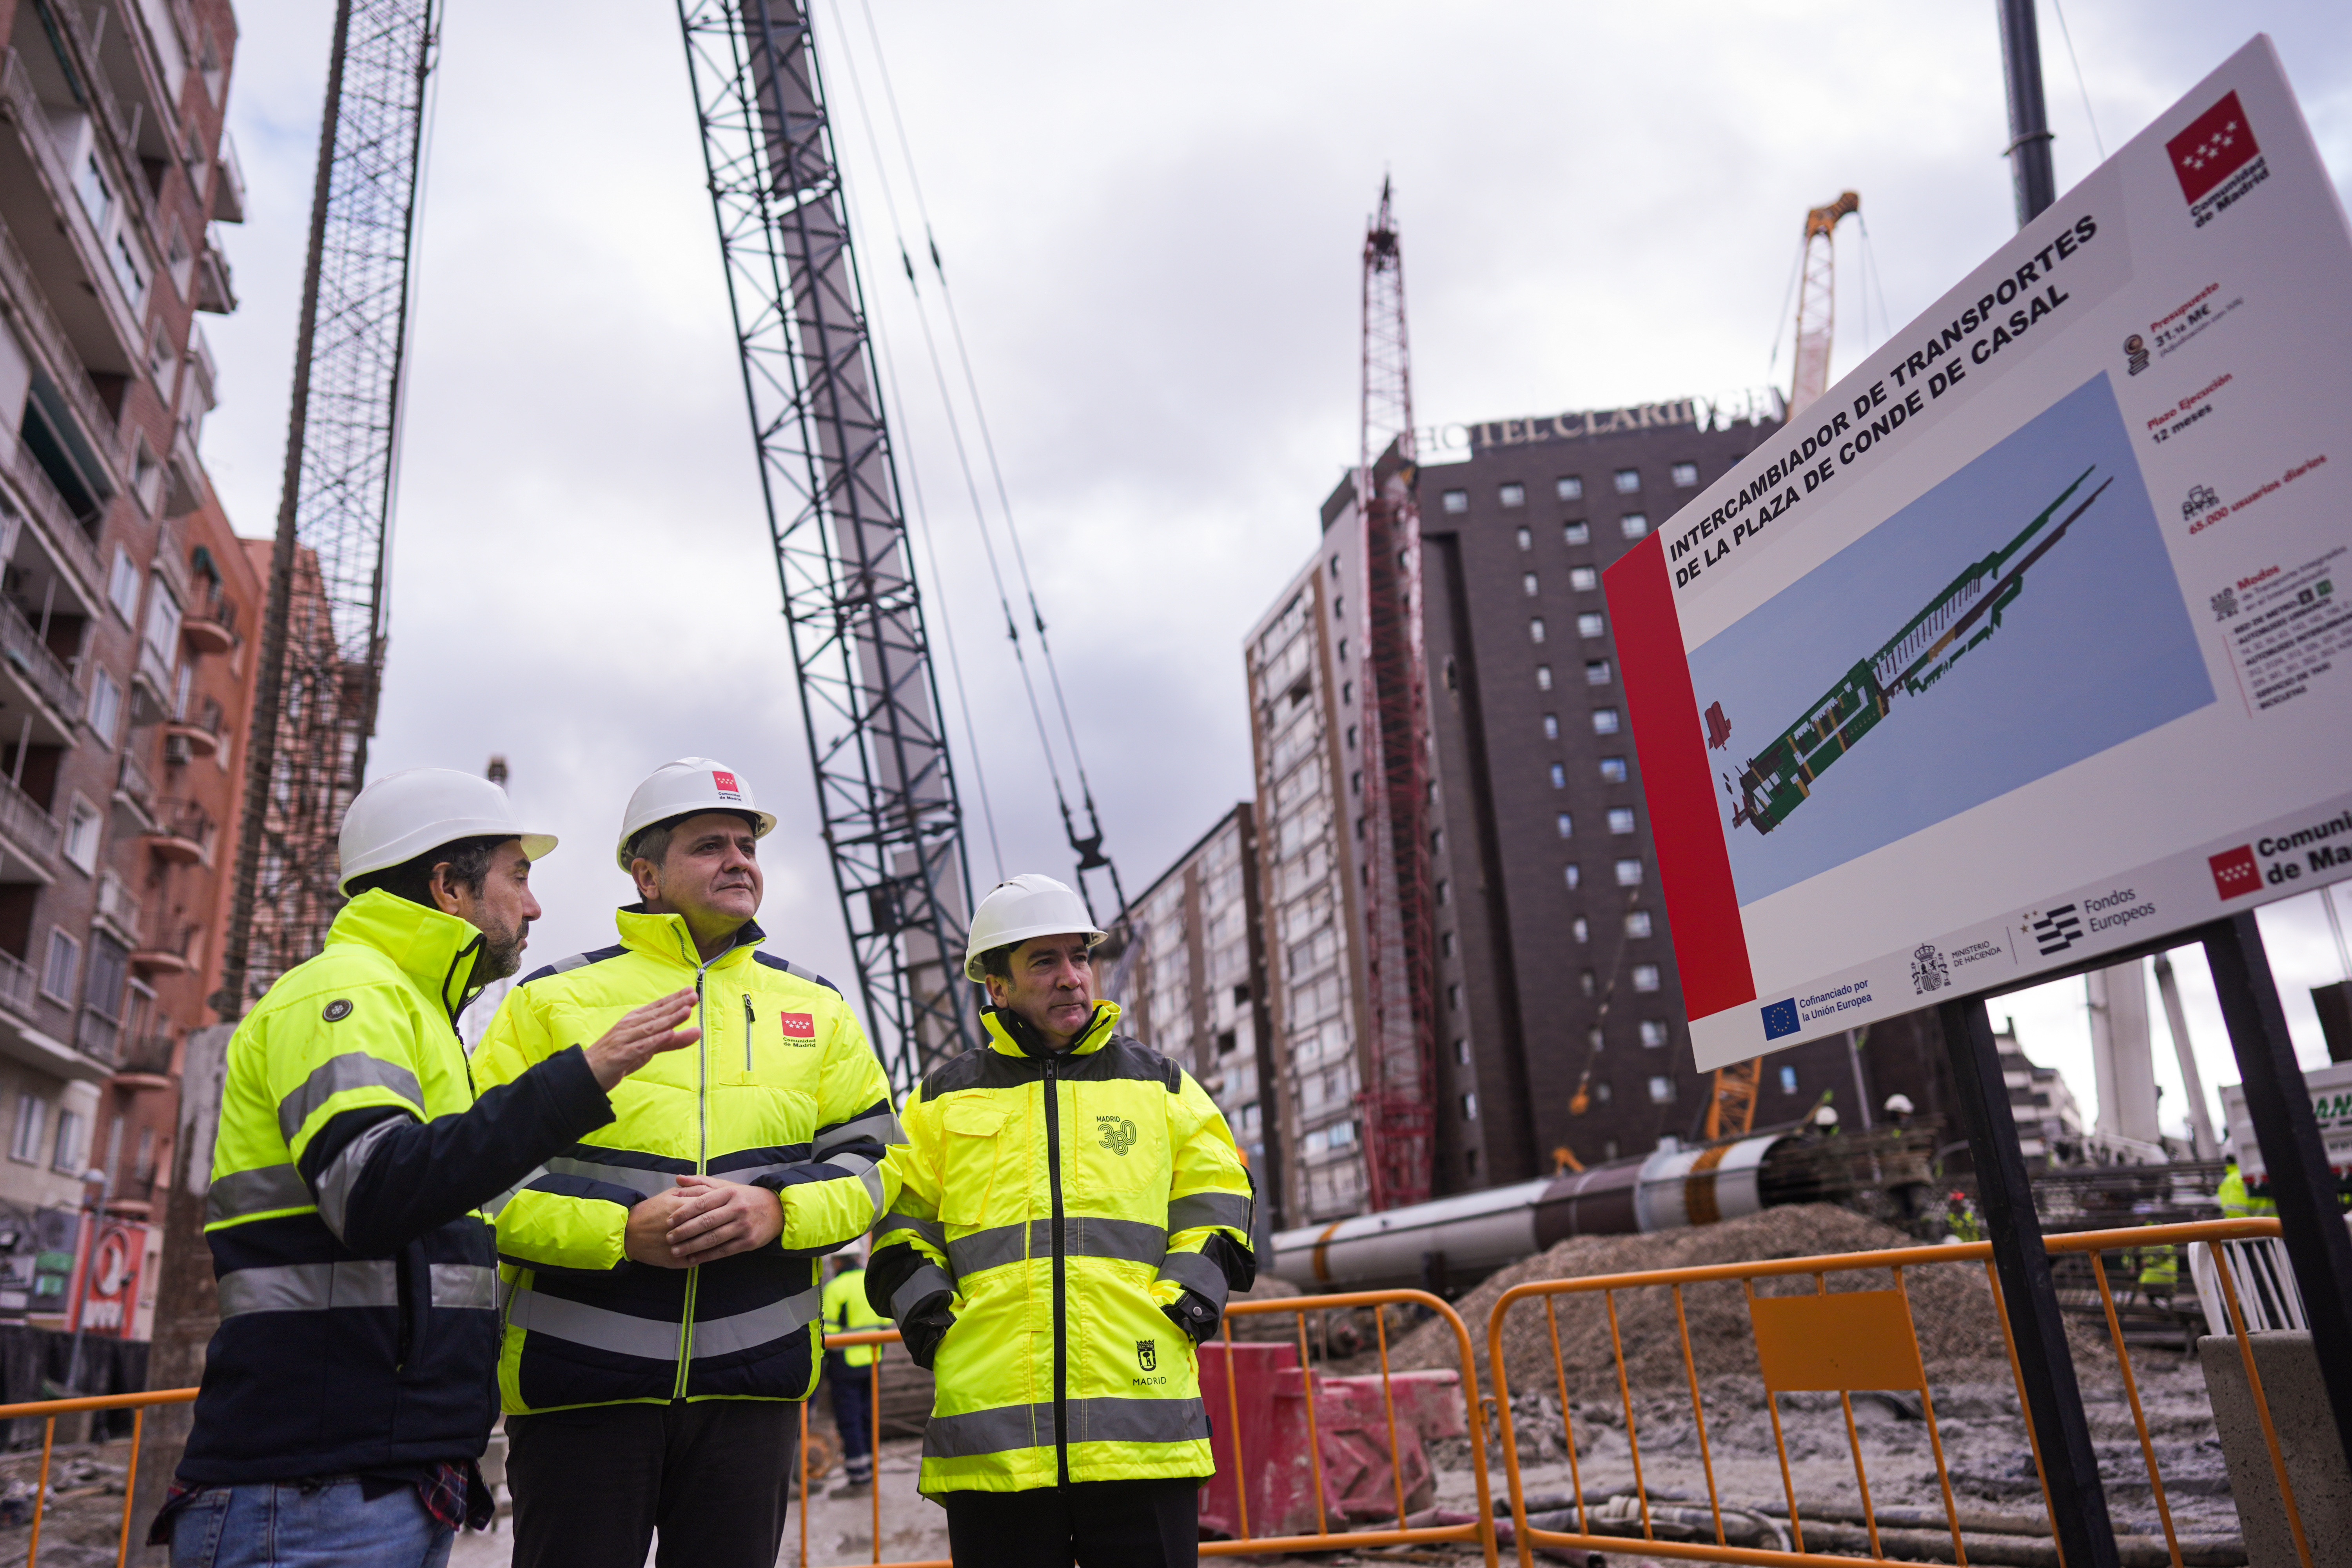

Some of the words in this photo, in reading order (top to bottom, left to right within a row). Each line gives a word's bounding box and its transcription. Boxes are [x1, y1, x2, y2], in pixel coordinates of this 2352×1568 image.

[2190, 156, 2265, 216] Comunidad
[2195, 211, 2214, 228] de
[2216, 166, 2270, 212] Madrid
[2150, 283, 2220, 332] Presupuesto
[1670, 411, 1851, 562] INTERCAMBIADOR
[1853, 380, 1887, 420] DE
[1890, 215, 2097, 387] TRANSPORTES
[2147, 408, 2177, 430] Plazo
[2179, 373, 2233, 411] Ejecución
[1413, 416, 1550, 452] HOTEL
[1676, 557, 1701, 588] DE
[1704, 538, 1730, 568] LA
[1733, 486, 1800, 546] PLAZA
[1804, 457, 1835, 494] DE
[1839, 388, 1924, 465] CONDE
[1928, 356, 1966, 399] DE
[1971, 284, 2069, 365] CASAL
[2152, 428, 2169, 444] 12
[2172, 404, 2213, 434] meses
[2189, 506, 2229, 535] 65.000
[2232, 481, 2281, 512] usuarios
[2283, 455, 2327, 483] diarios
[2237, 564, 2280, 591] Modos
[2267, 862, 2301, 885] de
[2084, 888, 2136, 914] Fondos
[2089, 902, 2156, 932] Europeos
[1951, 941, 1990, 959] MINISTERIO
[1954, 958, 1964, 967] DE
[1965, 946, 2002, 964] HACIENDA
[1800, 985, 1852, 1008] Cofinanciado
[1854, 980, 1868, 993] por
[1802, 1013, 1810, 1022] la
[1811, 1005, 1835, 1019] Unión
[1837, 994, 1873, 1011] Europea
[1098, 1120, 1136, 1156] 360
[1133, 1377, 1167, 1386] MADRID
